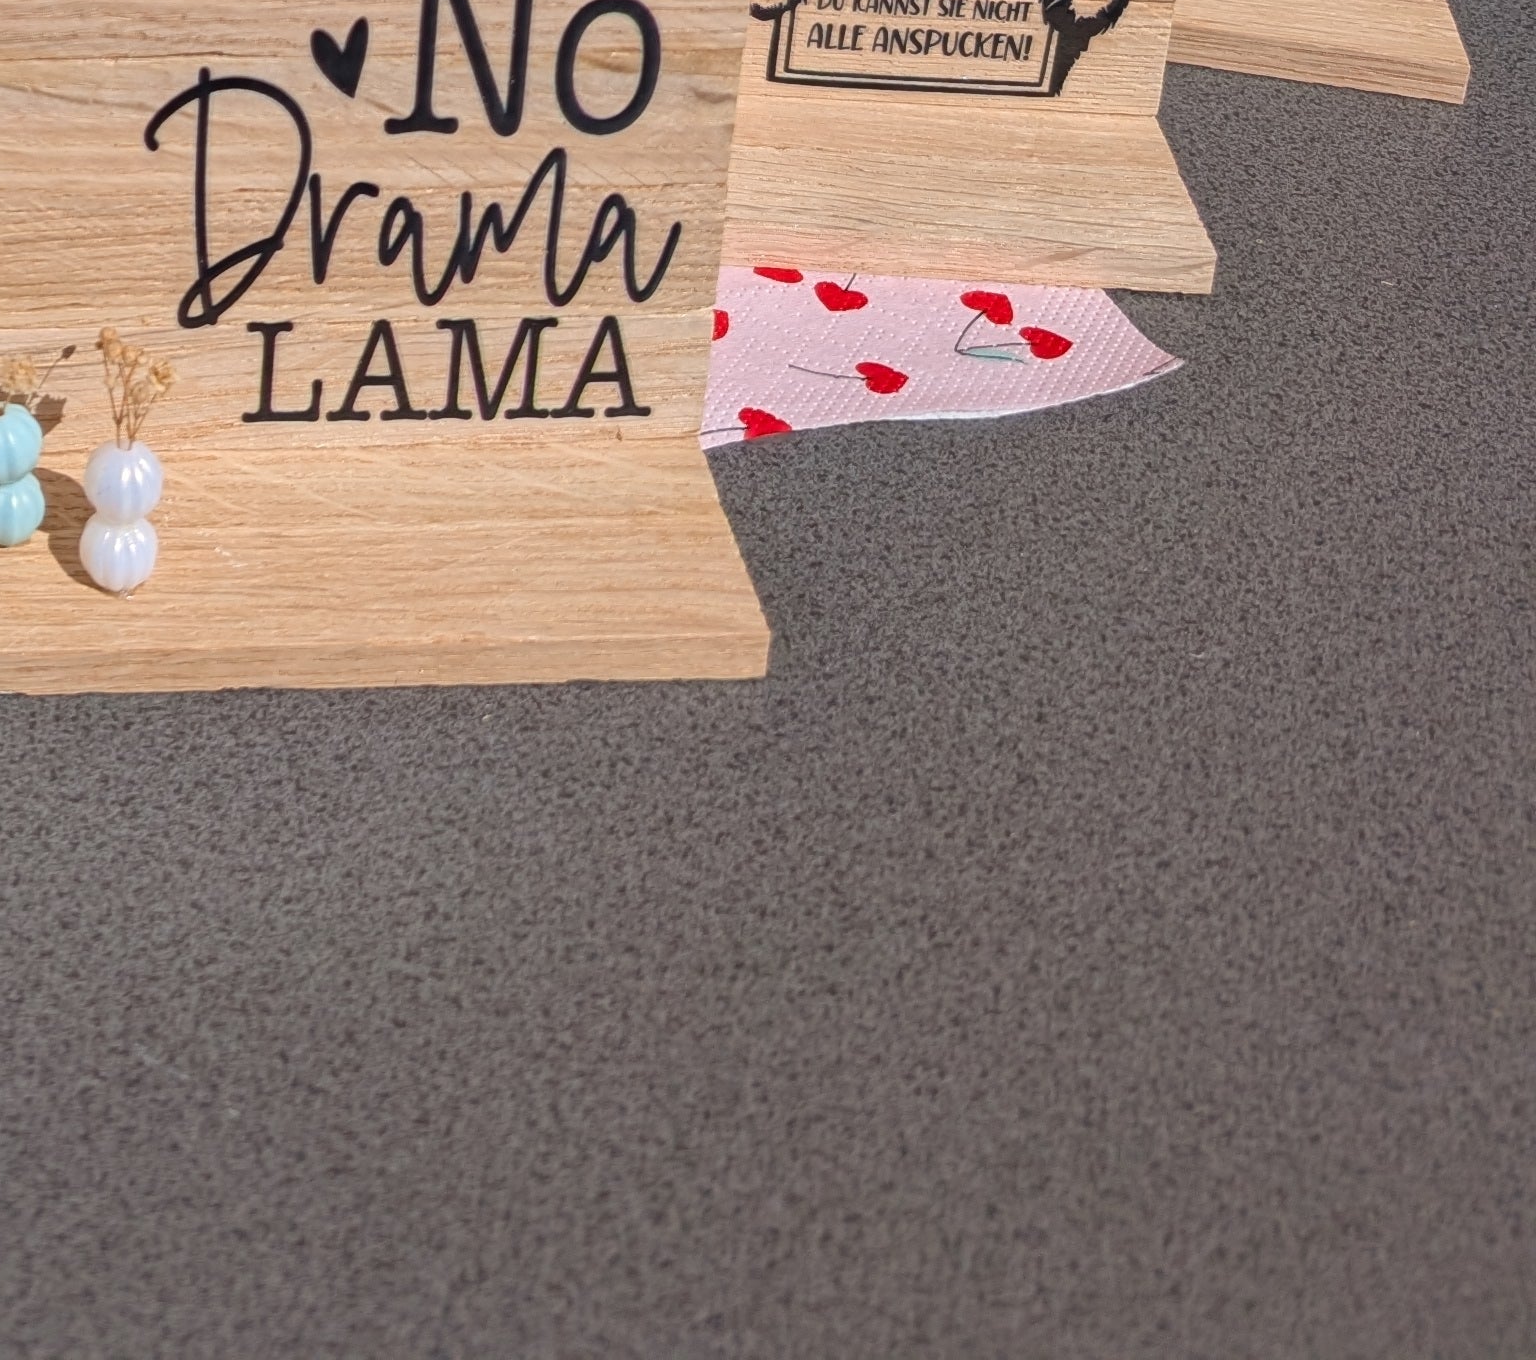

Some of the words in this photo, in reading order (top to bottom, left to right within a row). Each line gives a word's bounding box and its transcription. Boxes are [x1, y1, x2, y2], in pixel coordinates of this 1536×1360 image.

[807, 23, 867, 51] ALLE
[872, 26, 1033, 62] ANSPUCKEN!
[144, 66, 682, 330] Drama
[242, 316, 652, 423] LAMA
